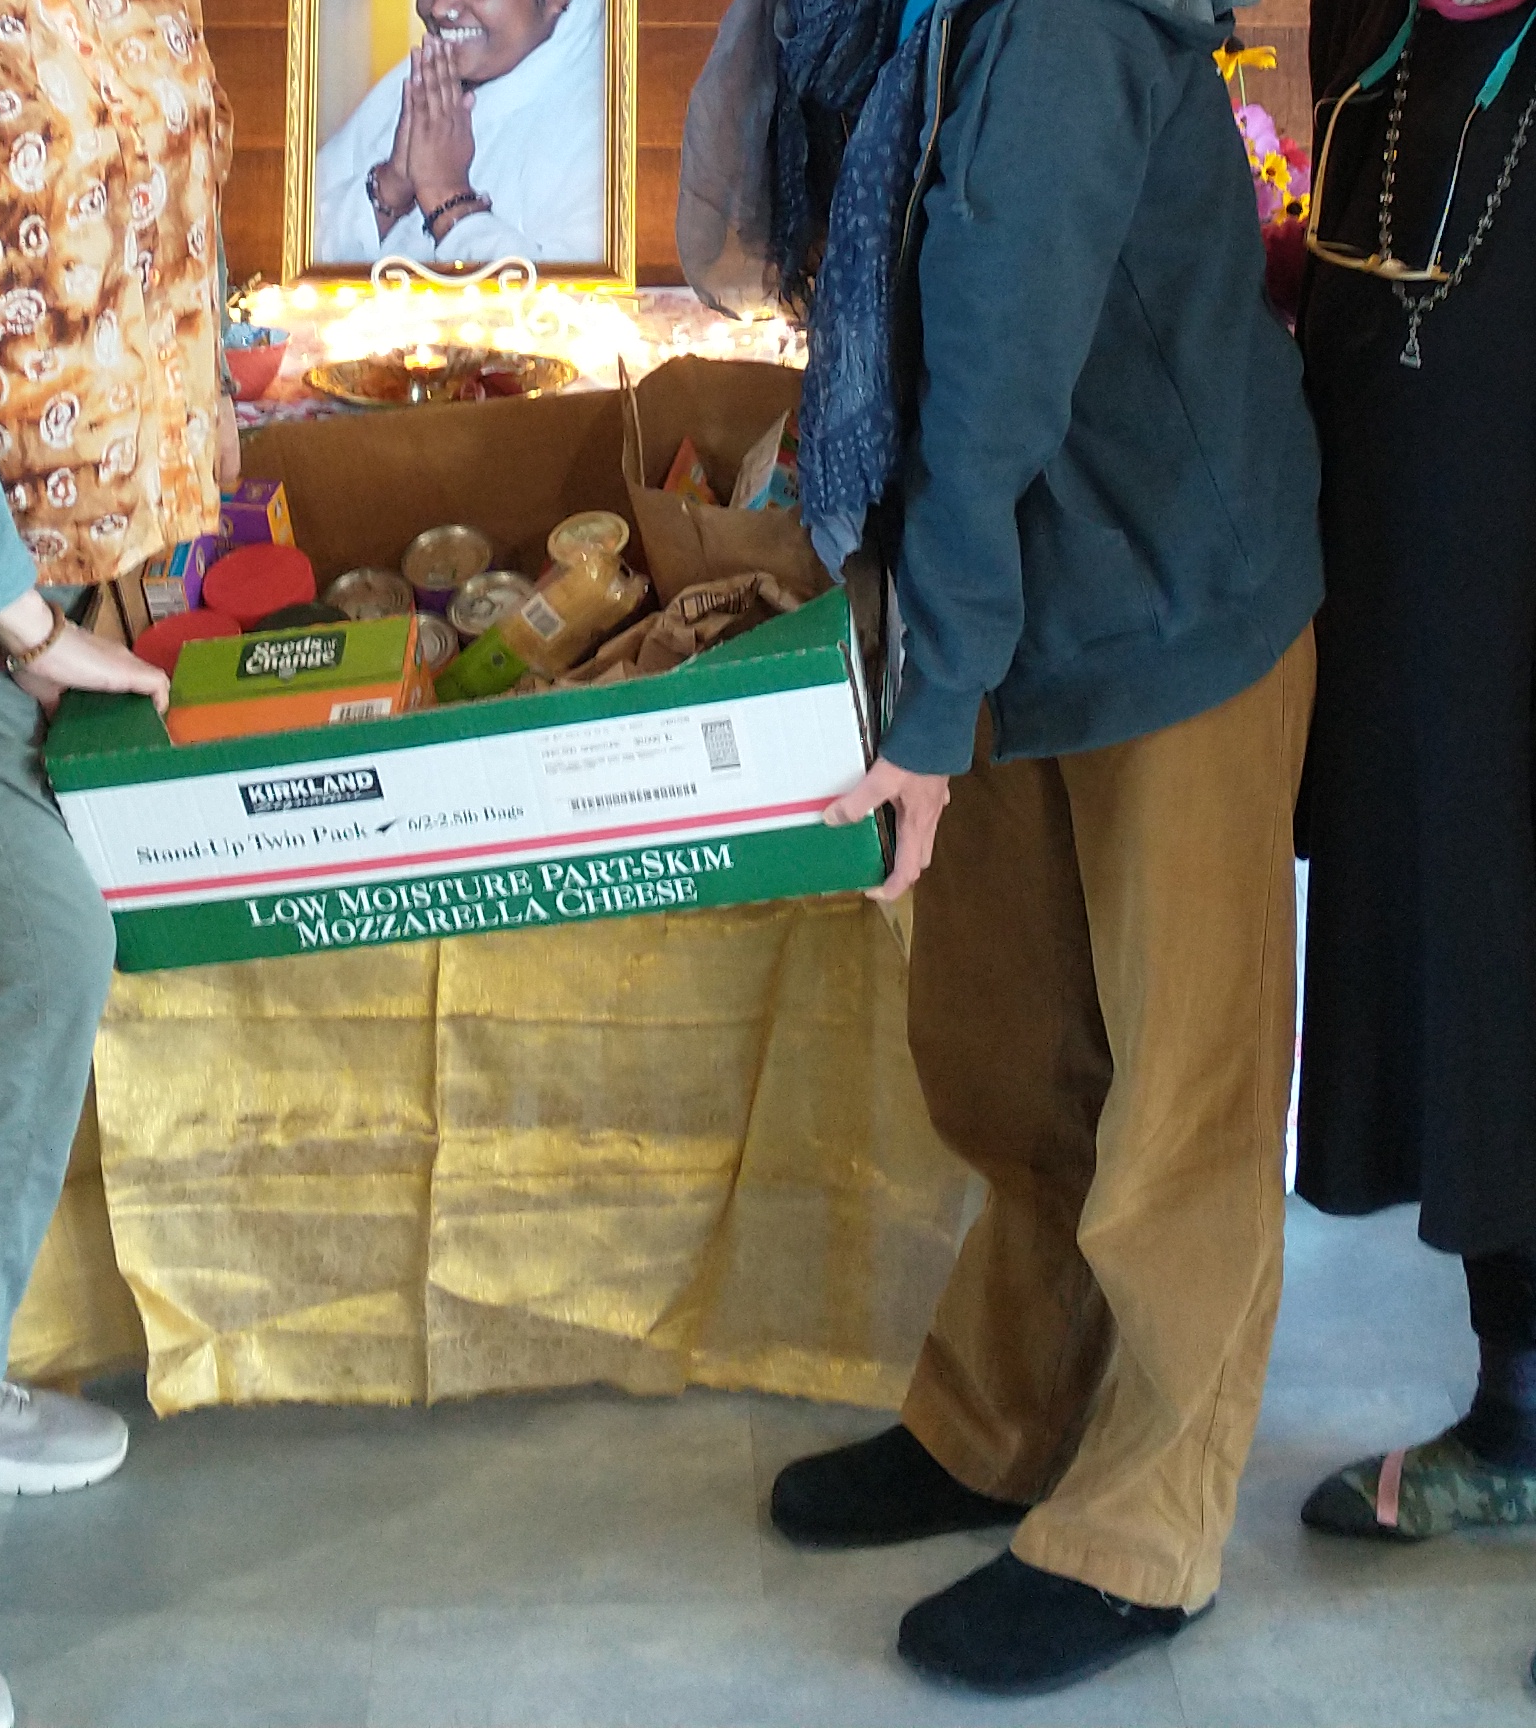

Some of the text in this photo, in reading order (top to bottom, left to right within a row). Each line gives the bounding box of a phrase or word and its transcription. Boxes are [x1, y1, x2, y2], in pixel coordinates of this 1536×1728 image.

[245, 650, 336, 675] Change
[254, 636, 323, 656] Seeds
[247, 770, 375, 805] KIRKLAND
[136, 822, 368, 865] Stand-Up Twin Pack
[245, 842, 734, 927] LOW MOISTURE PART-SKIM
[297, 877, 698, 949] MOZZARELLA CHEESE
